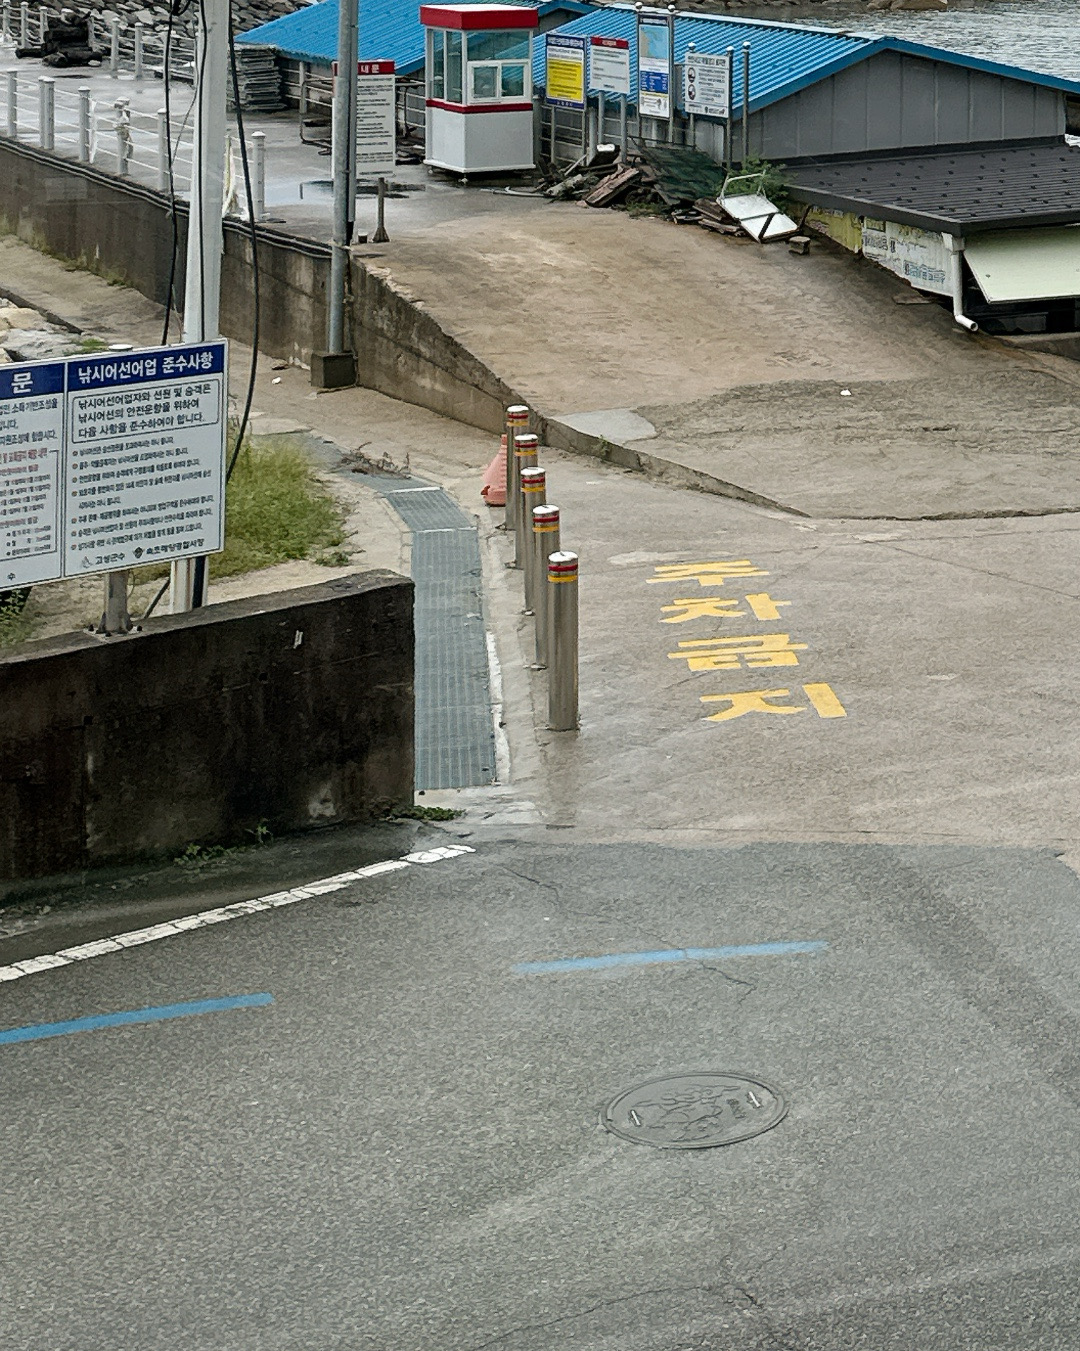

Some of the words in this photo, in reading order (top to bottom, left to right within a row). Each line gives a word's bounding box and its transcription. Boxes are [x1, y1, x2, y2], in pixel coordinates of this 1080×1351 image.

[78, 358, 157, 384] 낚시어선어업
[162, 352, 214, 373] 준수사항
[11, 372, 33, 394] 문
[78, 391, 151, 410] 낚시어선어업자와
[174, 388, 182, 398] 및
[78, 408, 123, 424] 낚시어선의
[174, 398, 199, 411] 위하여
[78, 426, 97, 438] 다음
[99, 422, 127, 435] 사항을
[129, 415, 174, 432] 준수하여야
[177, 412, 205, 425] 합니다.
[646, 560, 847, 722] 주차금지
